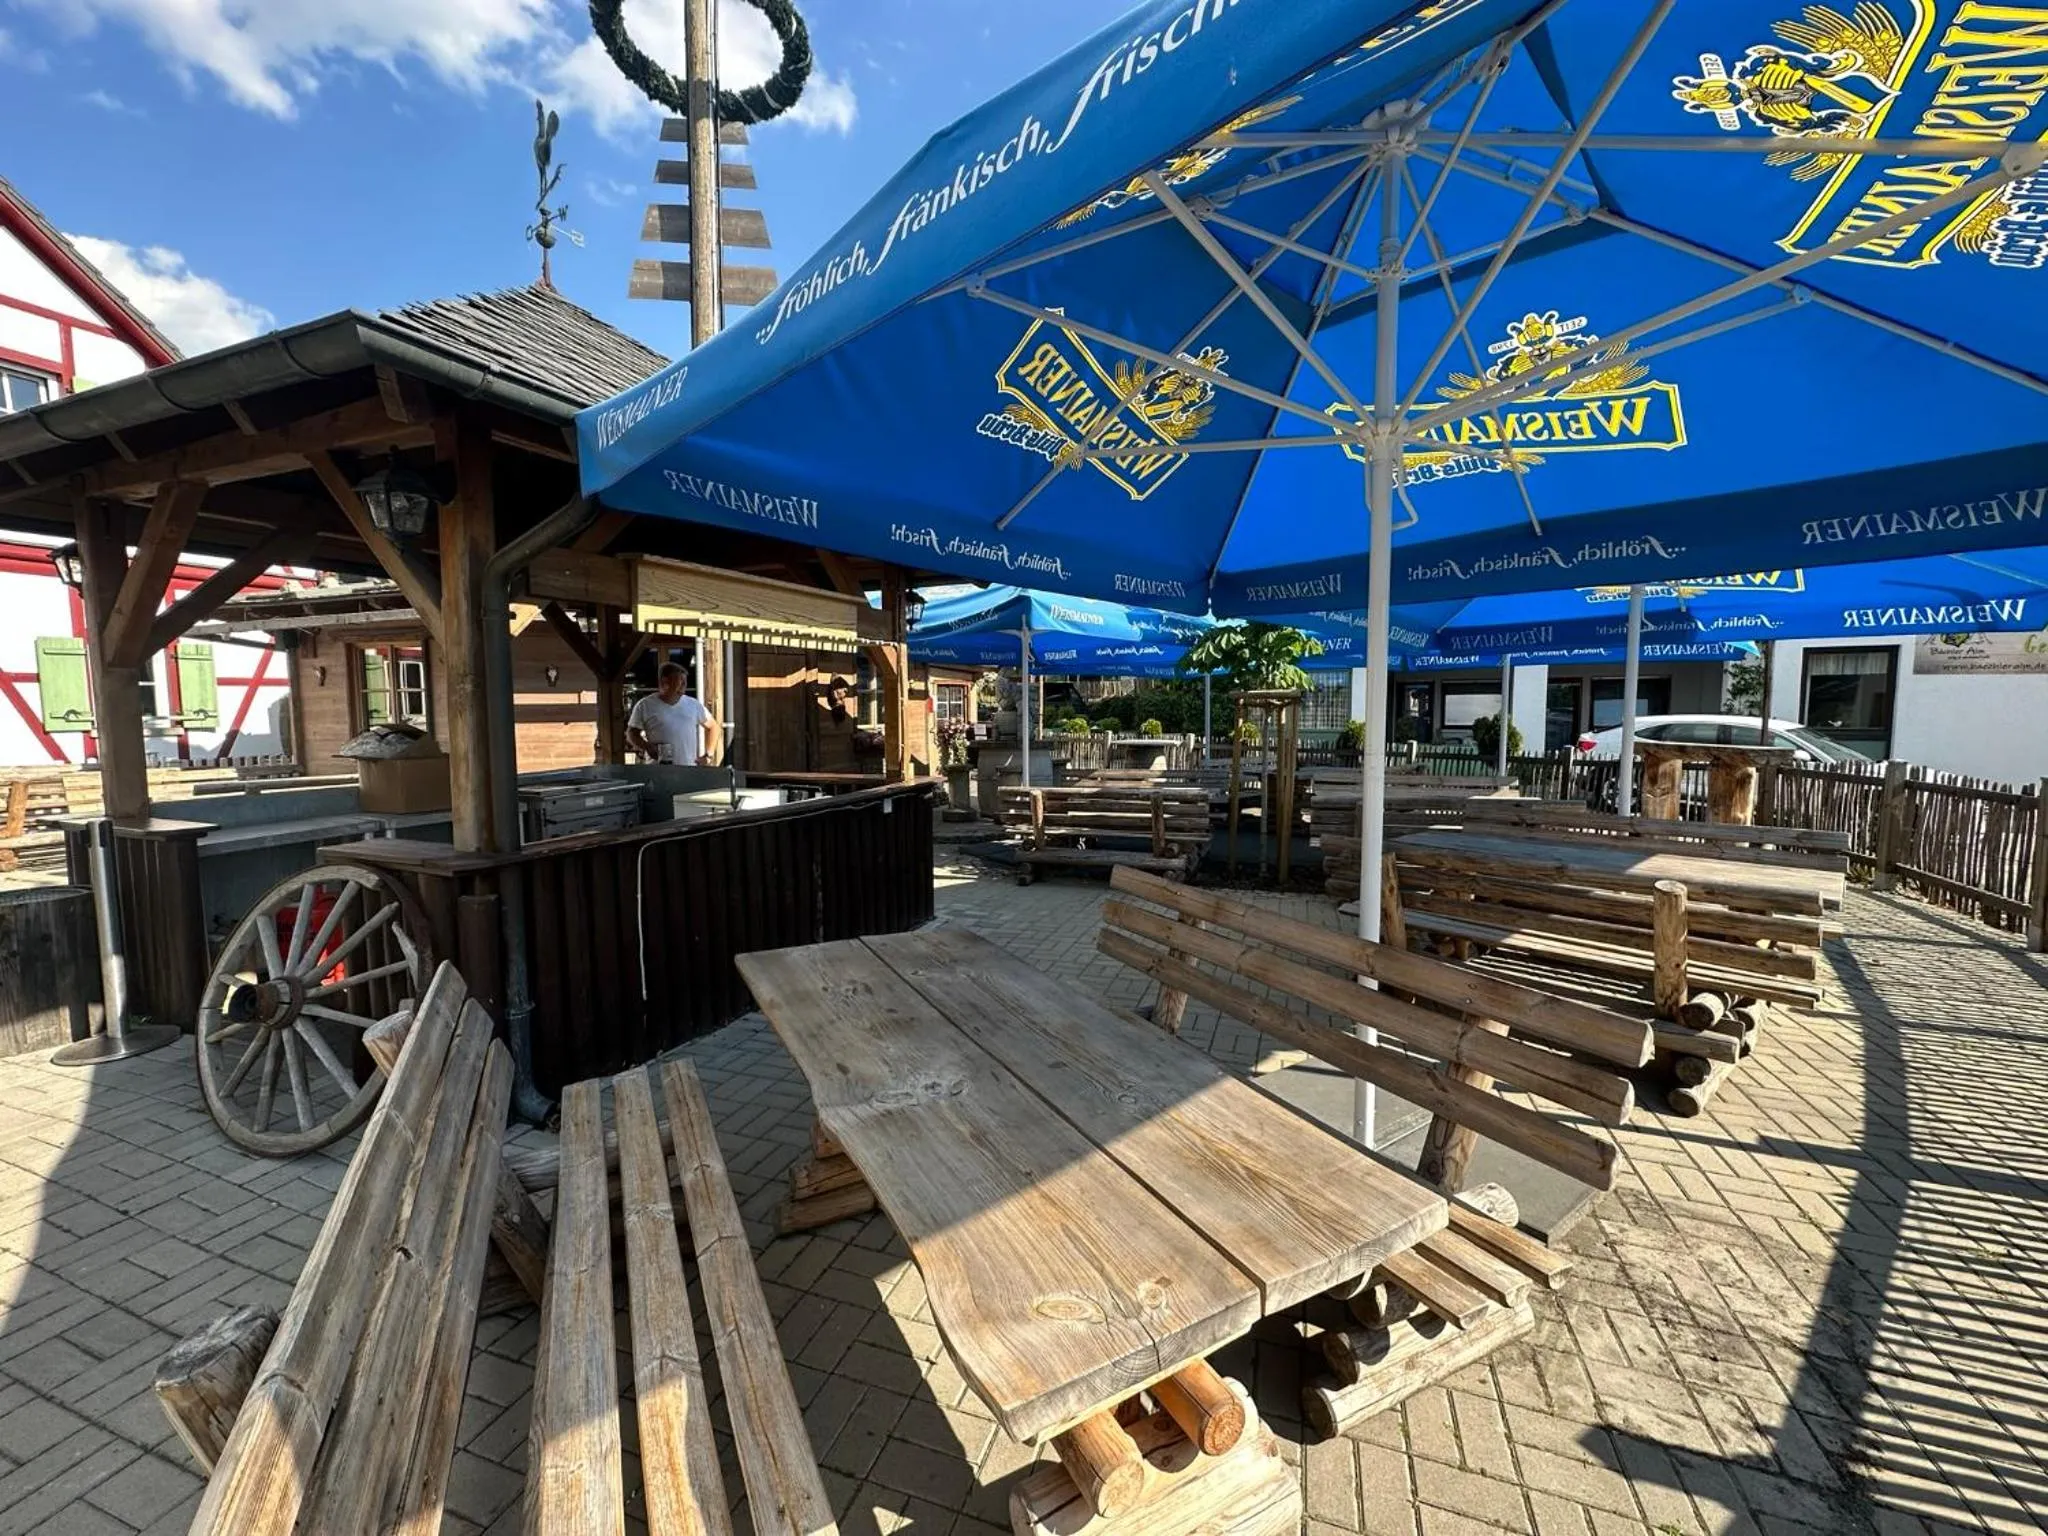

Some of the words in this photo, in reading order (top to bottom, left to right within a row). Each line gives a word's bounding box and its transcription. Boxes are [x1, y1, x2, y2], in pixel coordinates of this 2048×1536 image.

[866, 112, 1050, 275] fränkisch,
[1046, 0, 1239, 154] frisch
[596, 365, 688, 452] WEISMAINER
